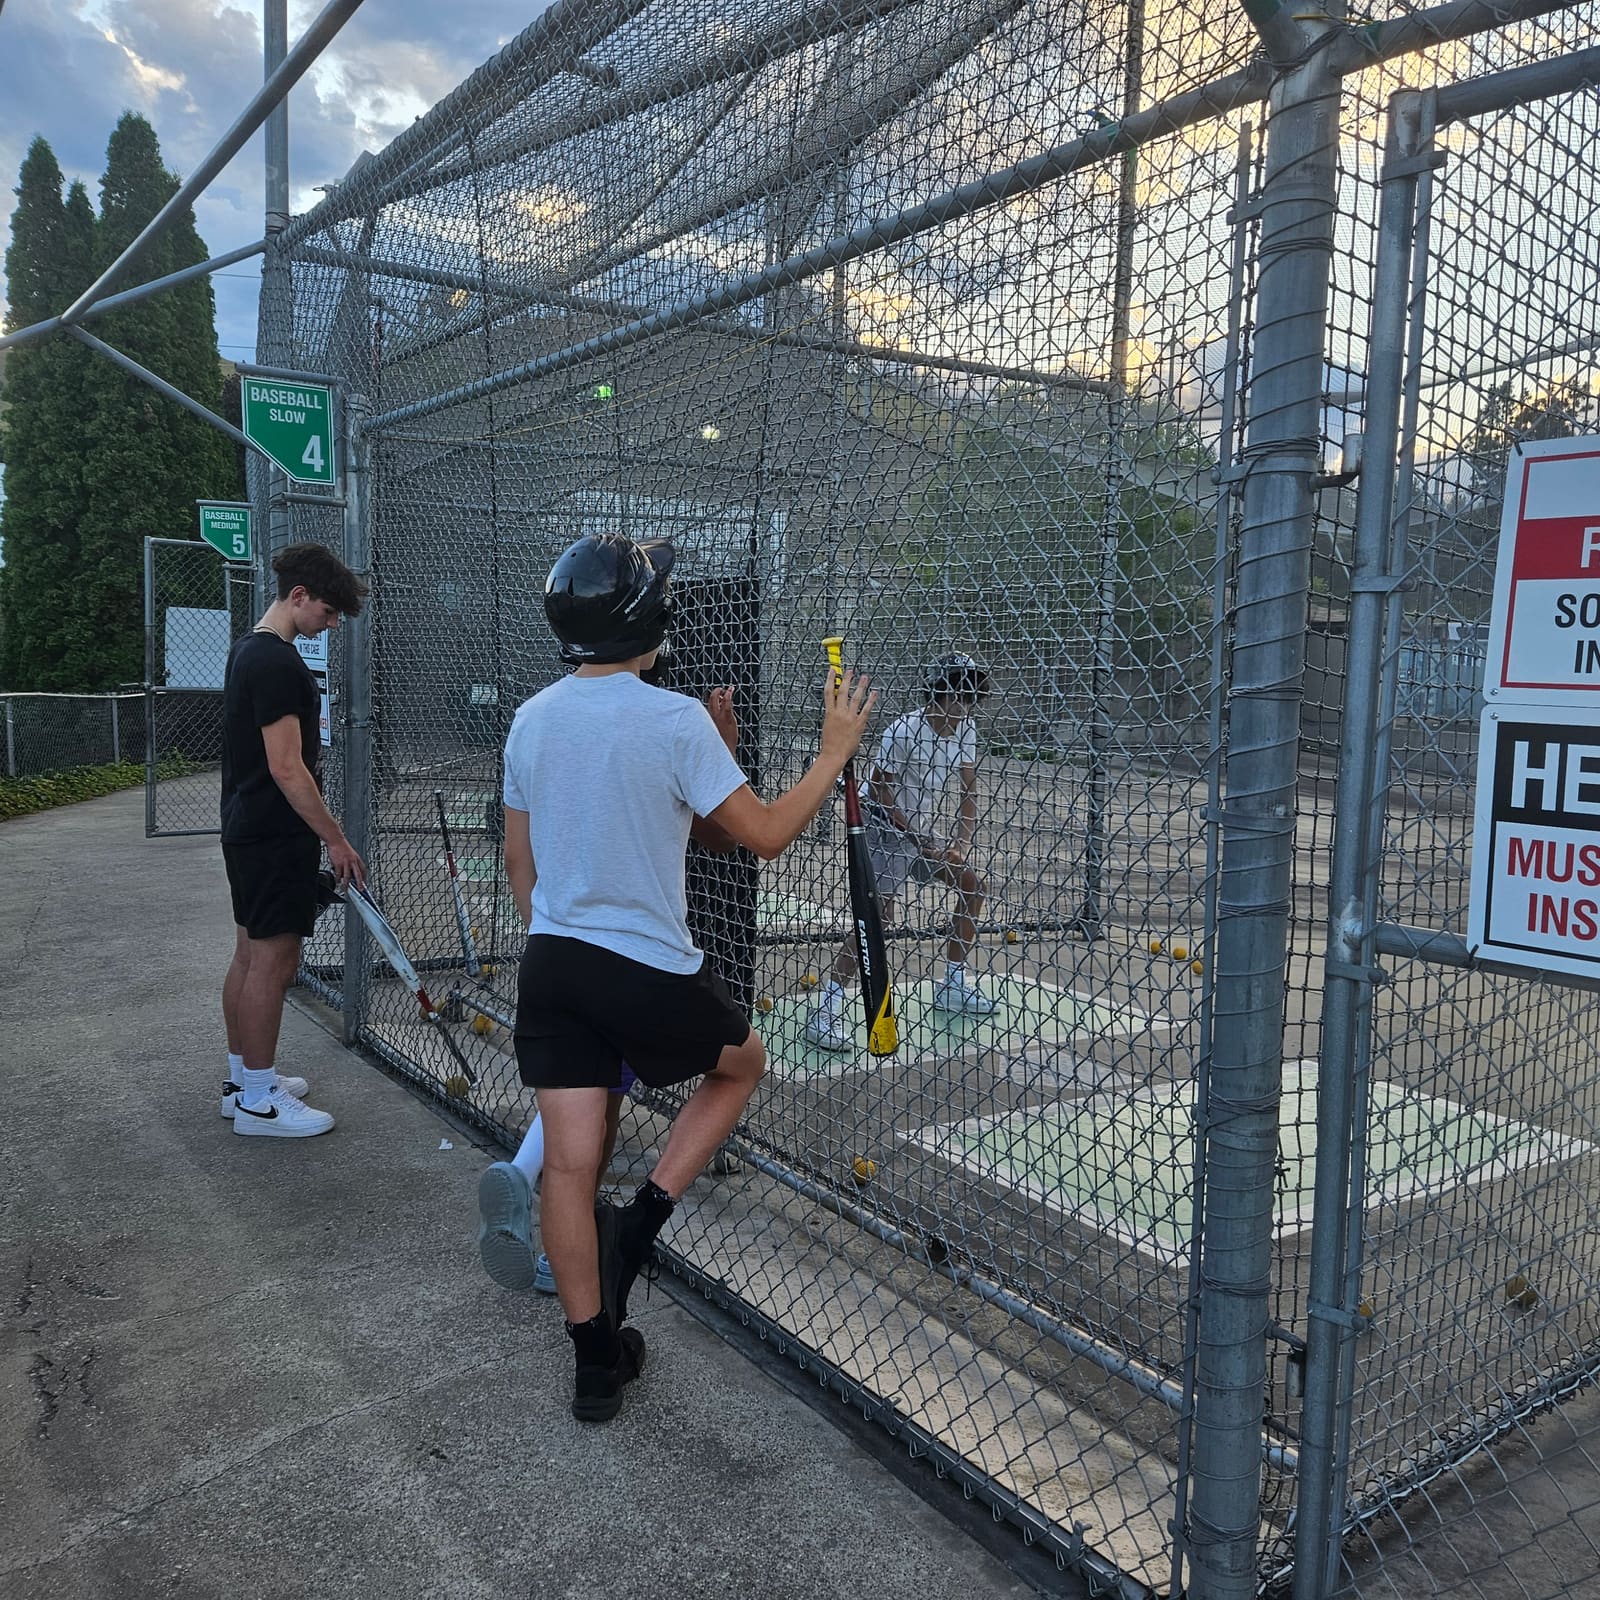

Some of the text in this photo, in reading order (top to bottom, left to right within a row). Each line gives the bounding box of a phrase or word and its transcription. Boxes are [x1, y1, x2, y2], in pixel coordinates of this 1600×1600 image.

[250, 386, 323, 410] BASEBALL
[269, 407, 306, 425] SLOW
[301, 434, 325, 473] 4
[204, 511, 246, 521] BASEBALL
[210, 520, 241, 530] MEDIUM
[232, 533, 246, 555] 5
[1554, 592, 1600, 628] SO
[1510, 739, 1600, 817] HE
[1507, 836, 1600, 887] MUS
[1527, 892, 1599, 941] INS
[858, 919, 871, 977] EASTON
